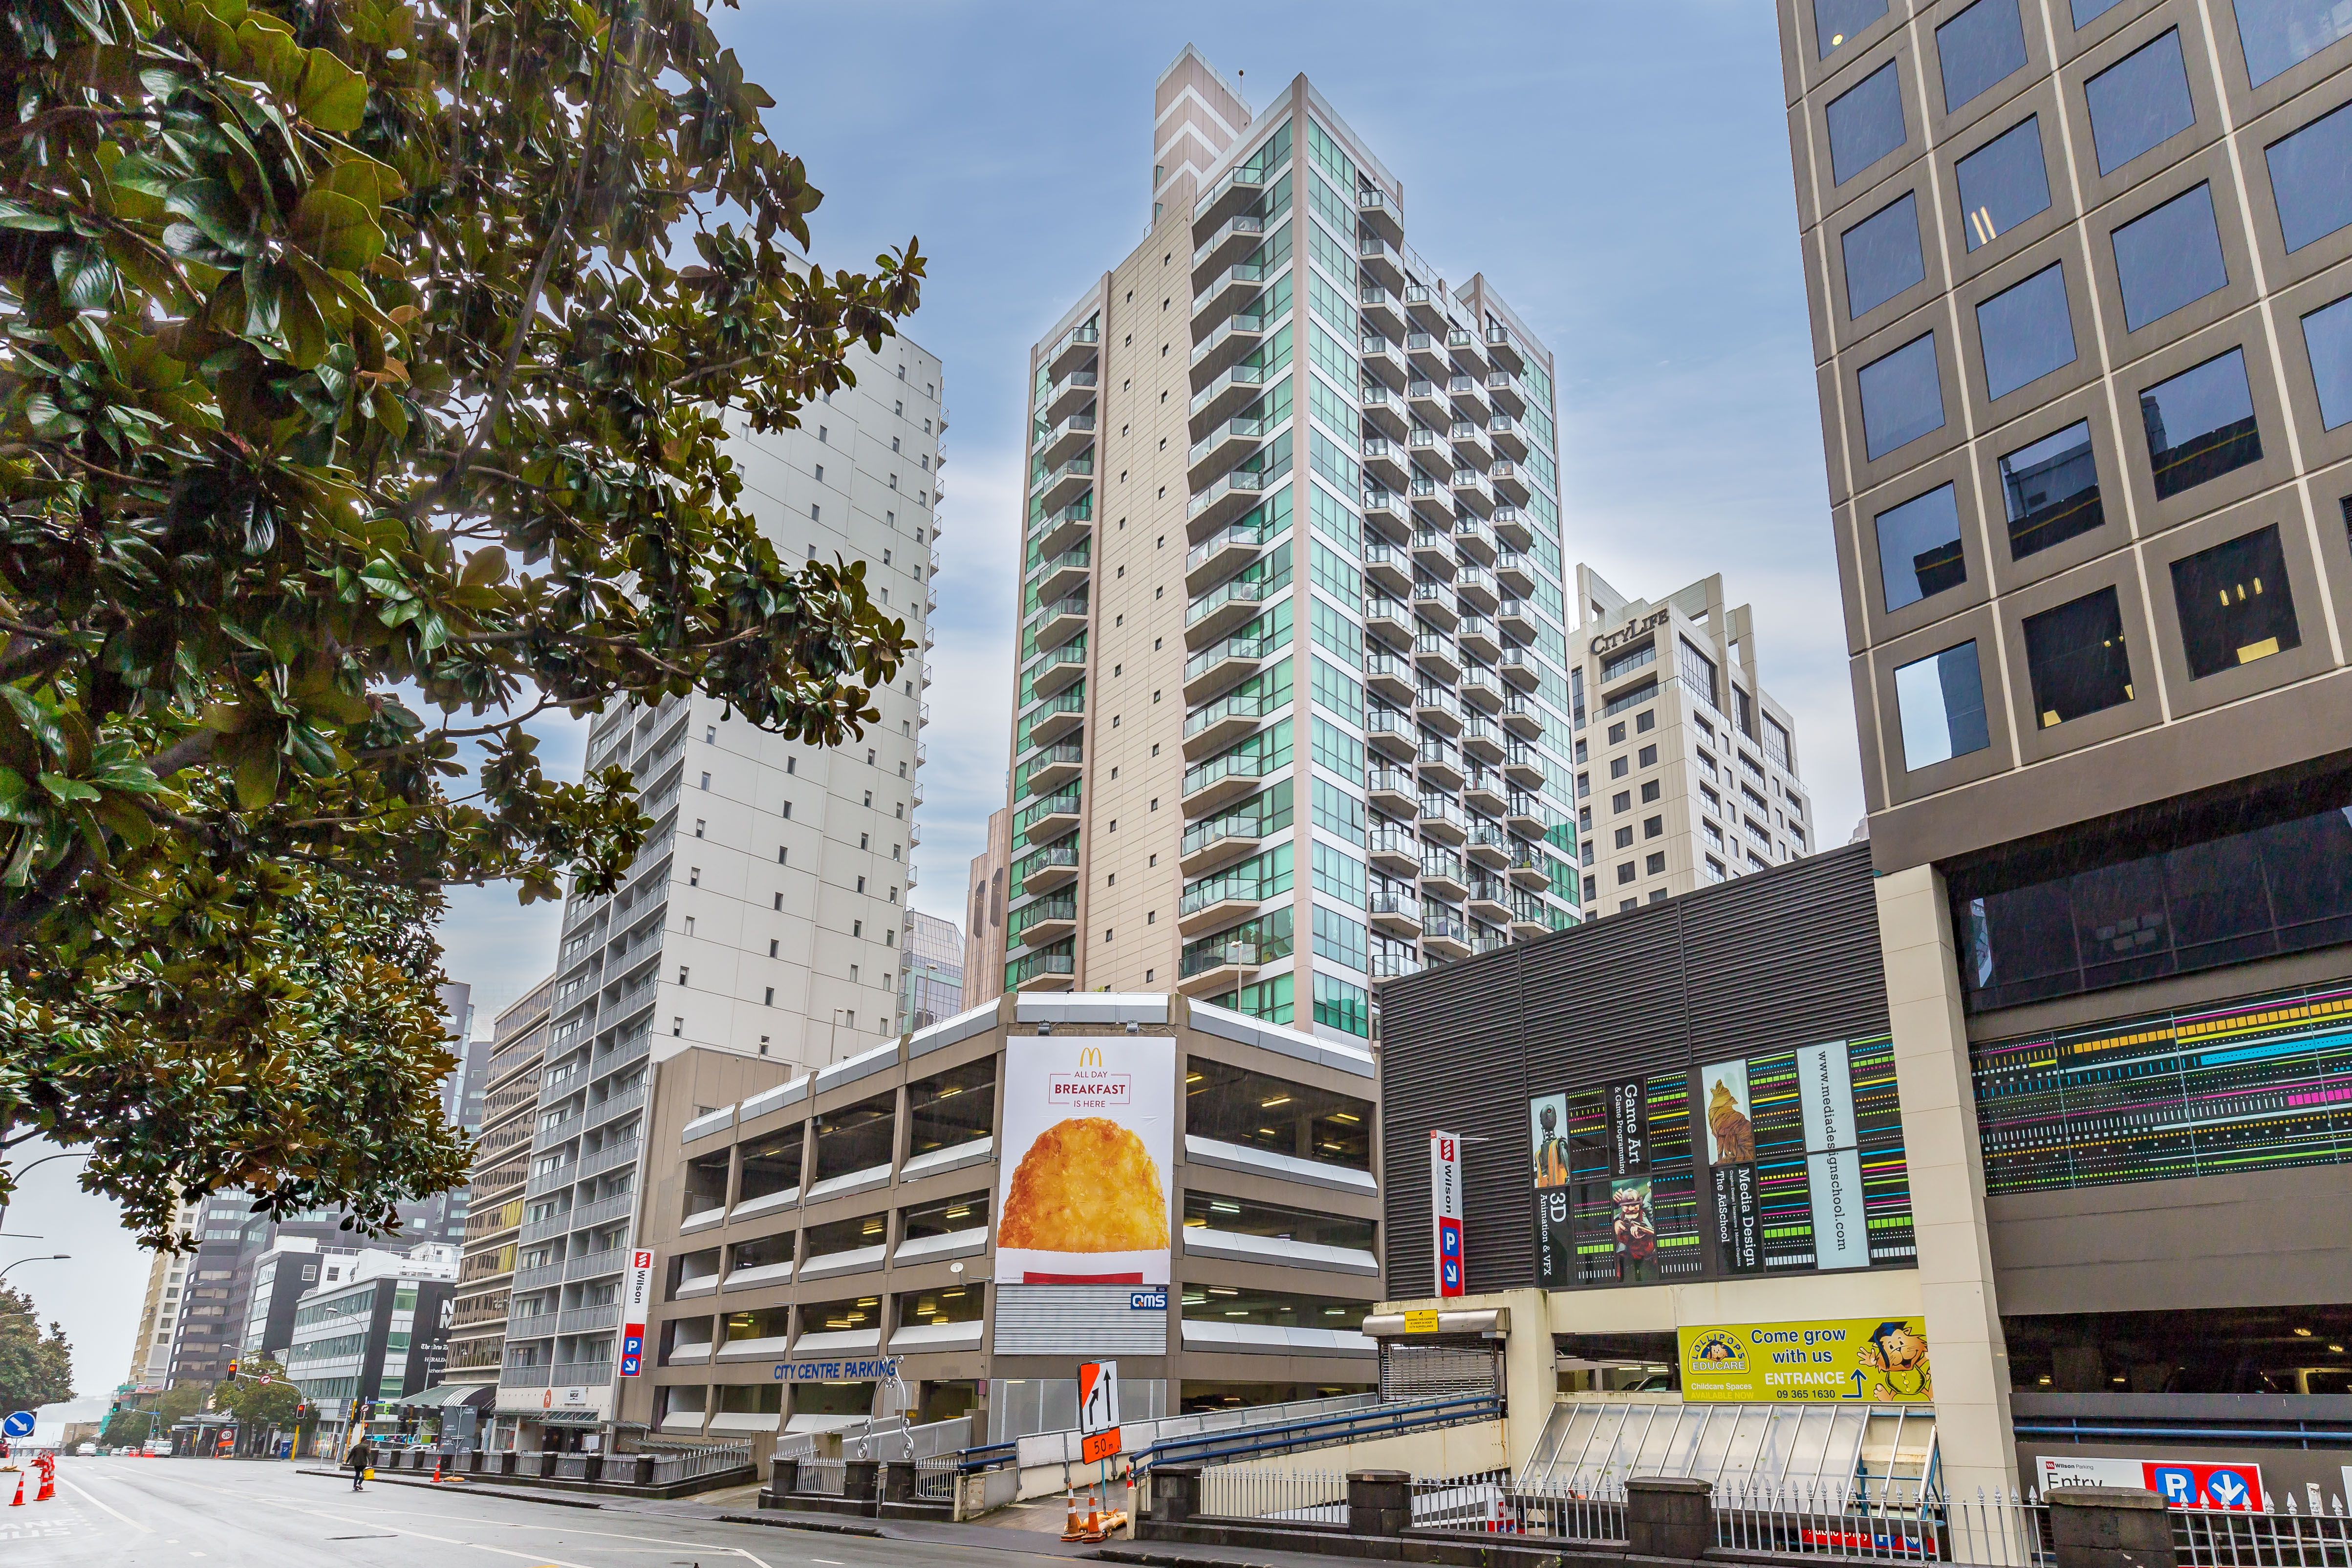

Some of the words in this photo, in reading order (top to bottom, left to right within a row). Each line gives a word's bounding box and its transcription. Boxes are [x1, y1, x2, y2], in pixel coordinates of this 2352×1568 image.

[1055, 1084, 1125, 1095] BREAKFAST
[1625, 1084, 1638, 1134] Game
[1617, 1120, 1626, 1174] Programming
[1628, 1138, 1641, 1164] Art
[1818, 1051, 1846, 1251] www.mediadesignschool.com
[1444, 1164, 1452, 1214] Wilson
[1716, 1171, 1725, 1191] The
[1739, 1168, 1752, 1213] Media
[1540, 1194, 1549, 1243] Animation
[1550, 1192, 1566, 1223] 3D
[1718, 1193, 1730, 1243] AdSchool
[1446, 1232, 1455, 1250] P
[1743, 1216, 1756, 1267] Design
[1543, 1254, 1552, 1276] VFX
[634, 1270, 646, 1304] Wilson
[1132, 1294, 1165, 1308] QMS
[628, 1340, 638, 1352] P
[1691, 1333, 1745, 1360] LOLLIPOPS
[1750, 1329, 1799, 1344] Come
[1804, 1329, 1846, 1346] grow
[1692, 1361, 1746, 1371] EDUCARE
[1772, 1349, 1807, 1364] with
[1812, 1351, 1833, 1363] us
[774, 1364, 797, 1380] CITY
[798, 1362, 841, 1379] CENTRE
[844, 1359, 896, 1378] PARKING
[1765, 1372, 1846, 1385] ENTRANCE
[1726, 1383, 1752, 1391] Spaces
[1776, 1390, 1789, 1398] 09
[1791, 1390, 1809, 1398] 365
[1812, 1390, 1835, 1398] 1630
[1094, 1438, 1106, 1455] 50
[2165, 1473, 2187, 1497] P
